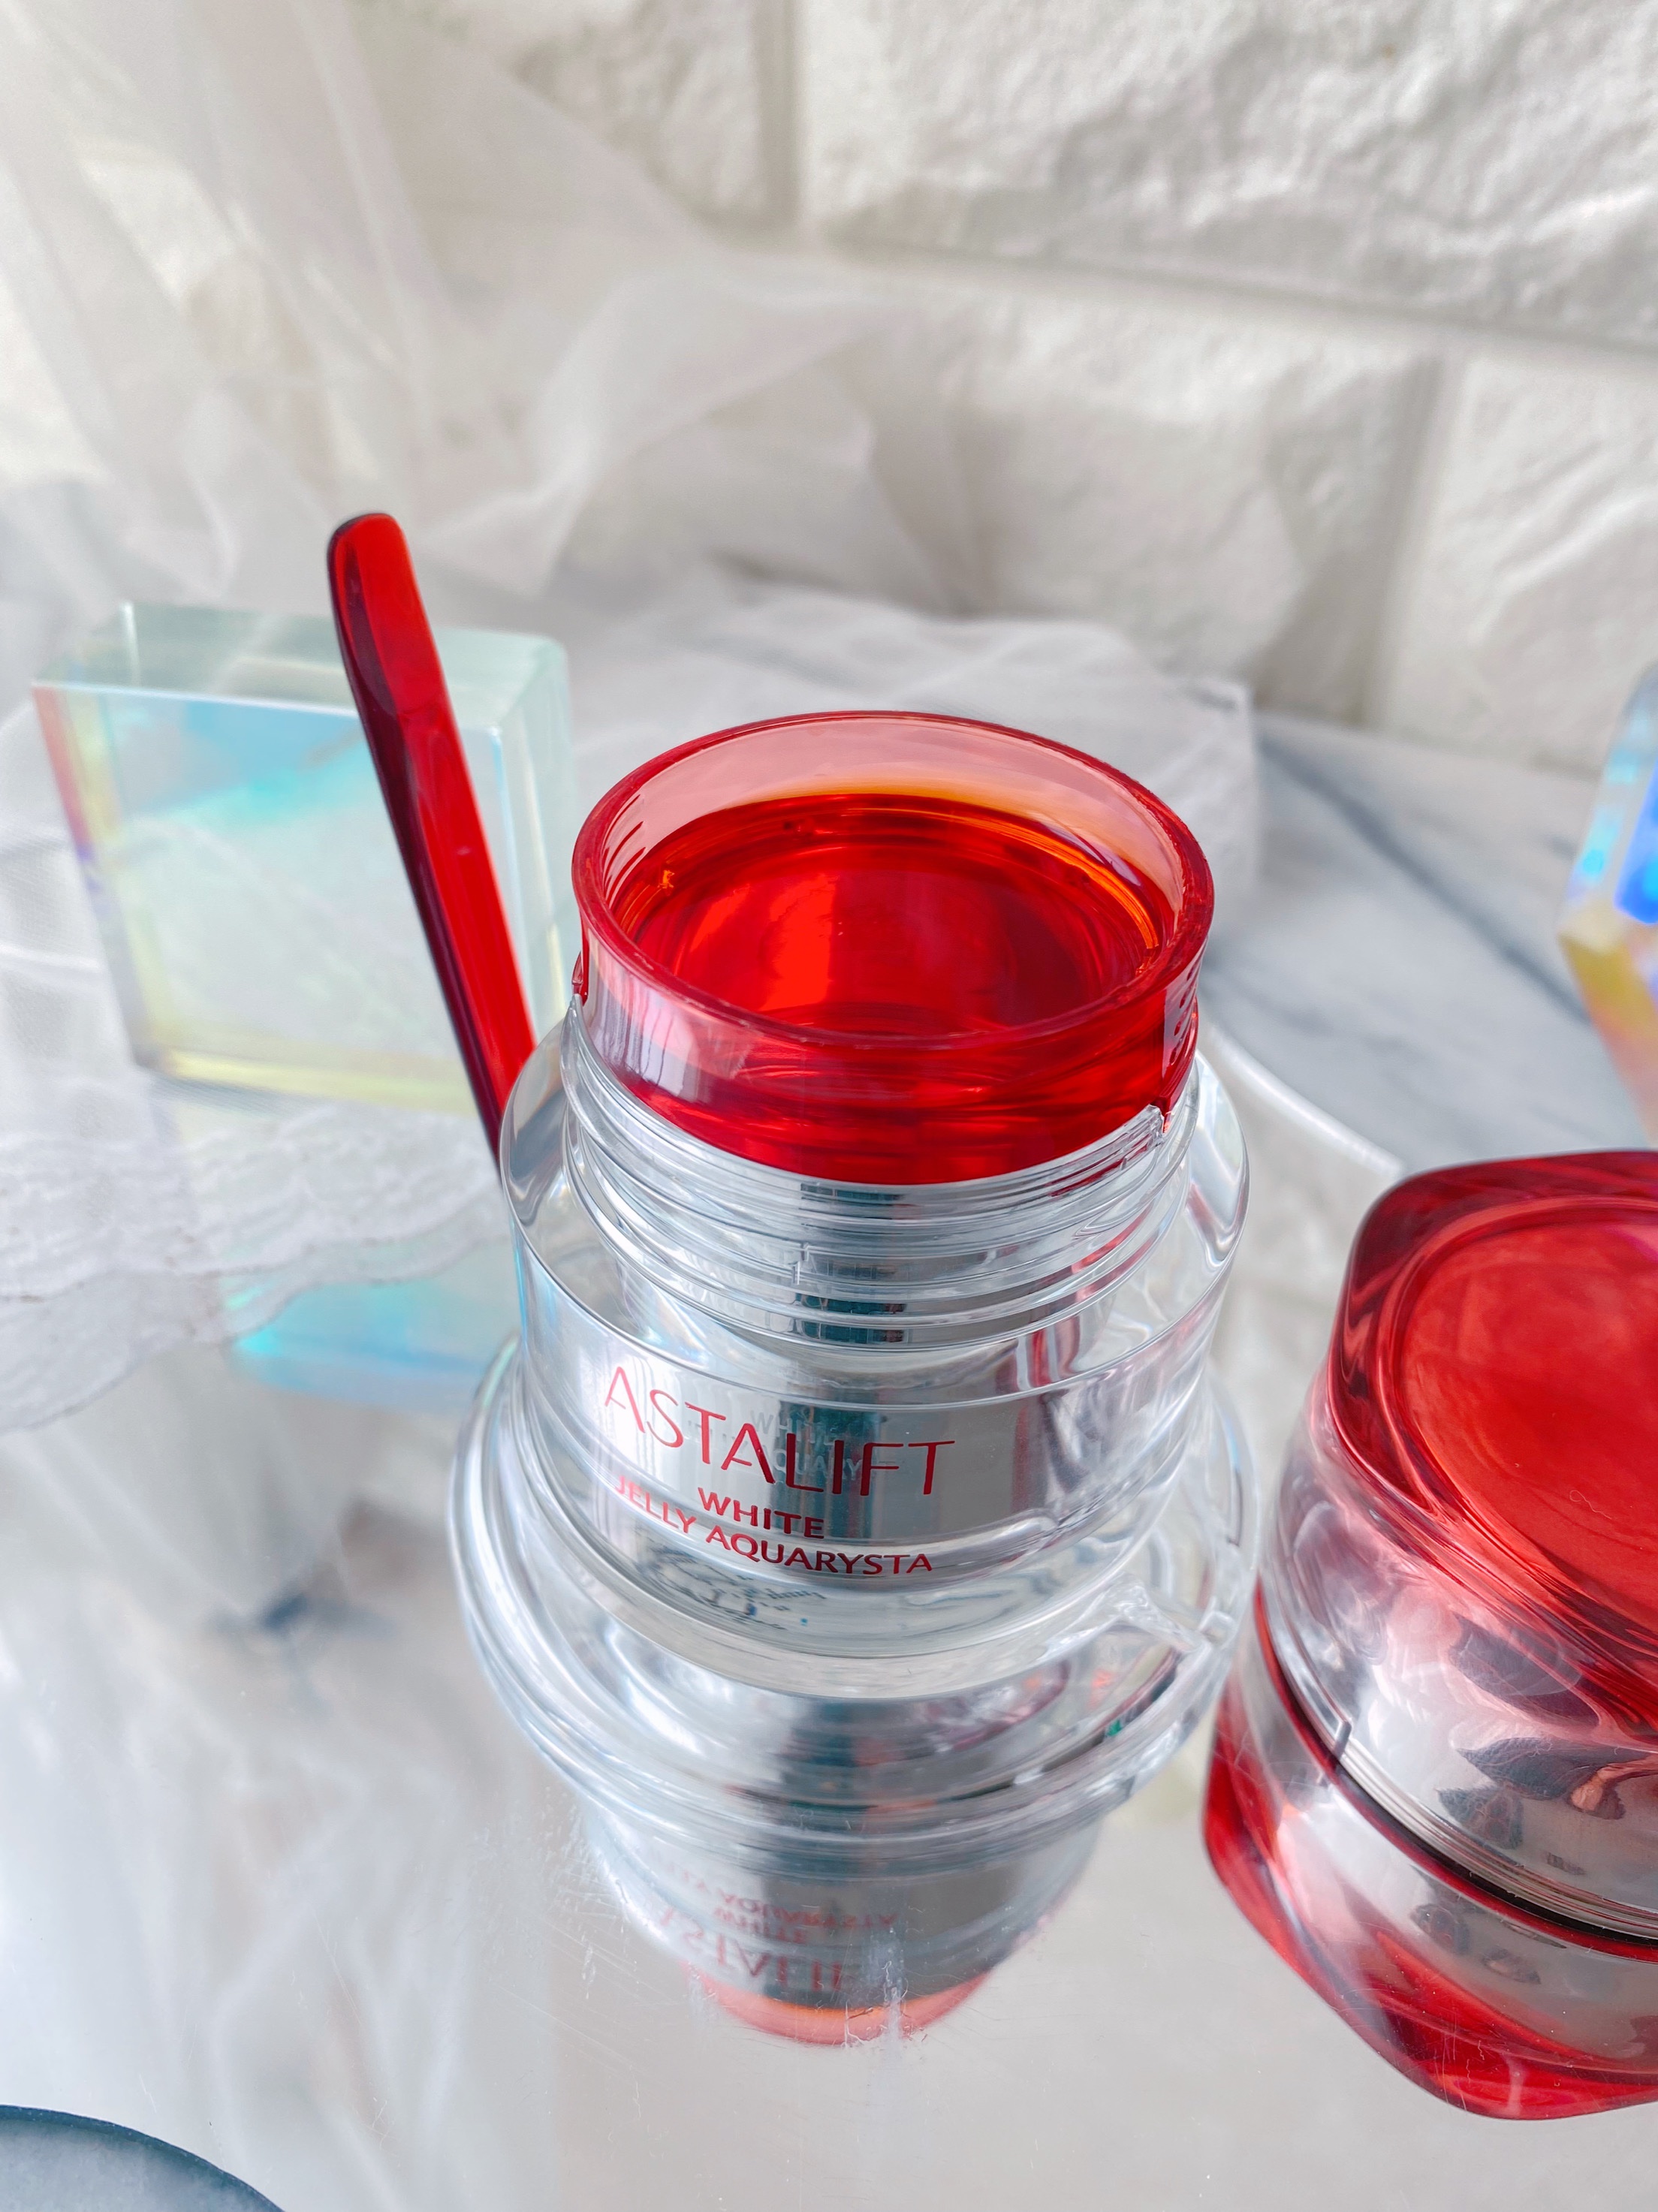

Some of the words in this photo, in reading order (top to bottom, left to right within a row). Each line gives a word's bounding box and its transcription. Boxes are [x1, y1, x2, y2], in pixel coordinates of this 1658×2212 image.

[604, 1366, 956, 1496] ASTALIFT
[616, 1476, 697, 1533] JELLY
[706, 1525, 933, 1575] AQUARYSTA
[698, 1487, 824, 1538] WHITE
